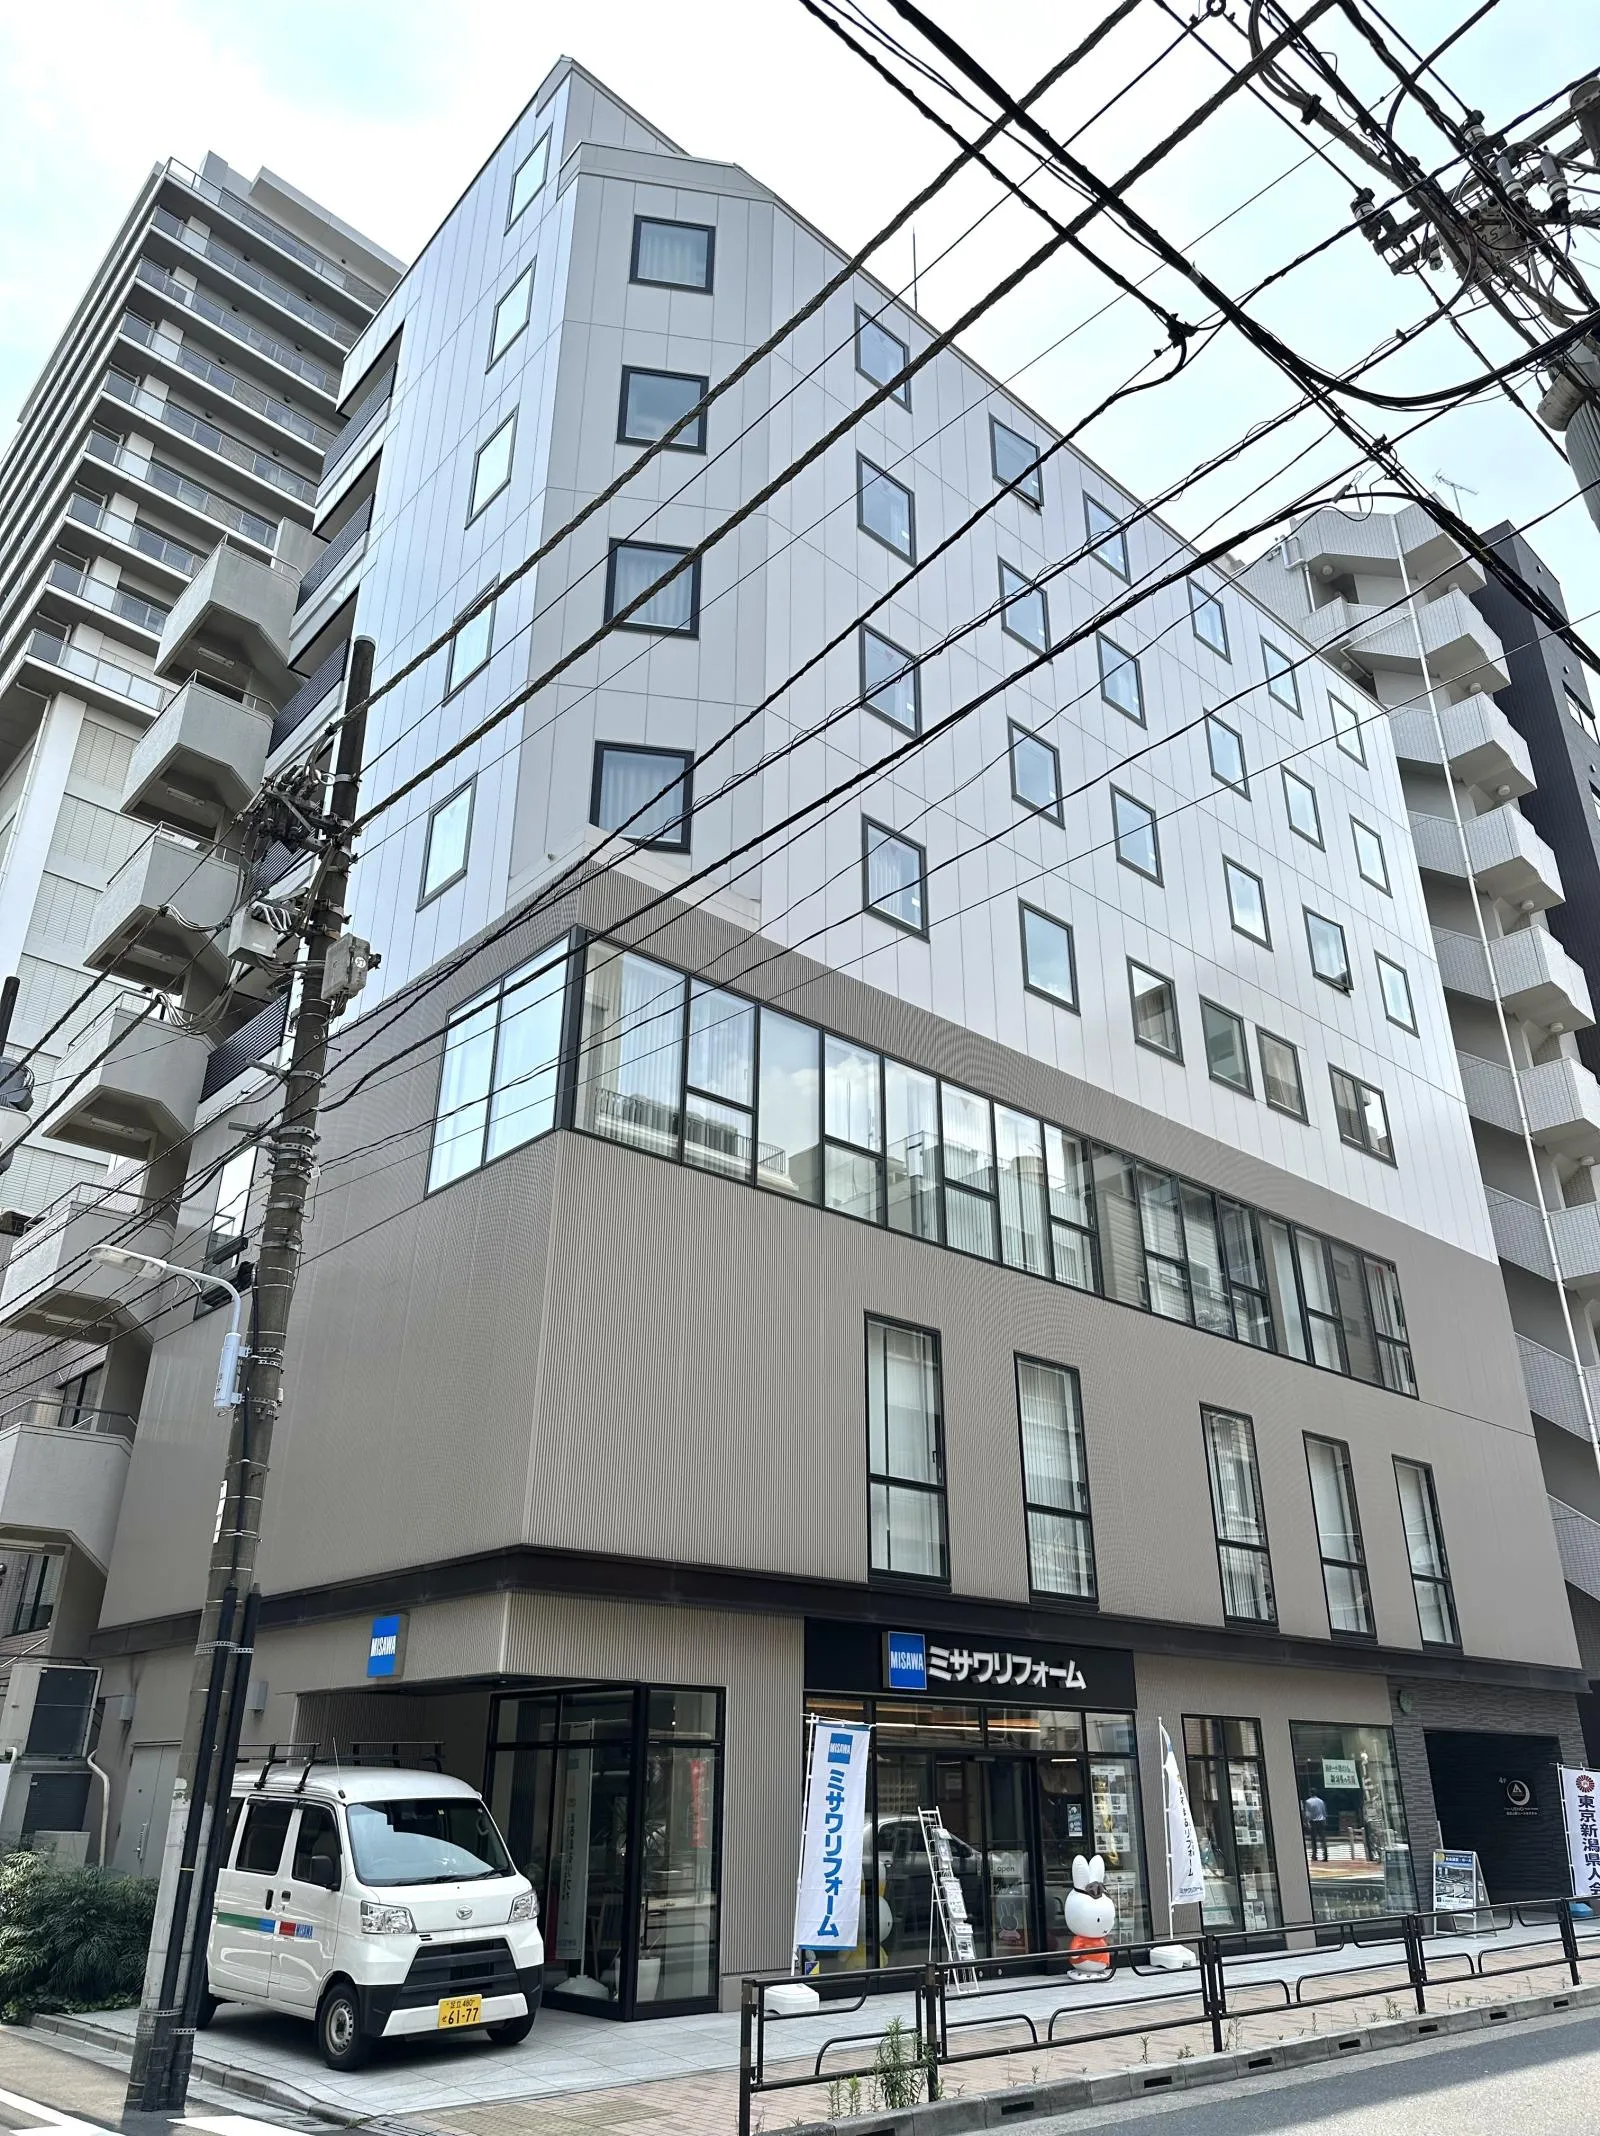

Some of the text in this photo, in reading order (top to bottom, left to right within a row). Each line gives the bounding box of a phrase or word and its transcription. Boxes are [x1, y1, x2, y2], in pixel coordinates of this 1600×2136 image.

[370, 1635, 396, 1657] MISAWA
[890, 1646, 1087, 1690] MISAWA ミサワリフォーム
[817, 1768, 845, 1938] ミサワリフォーム
[448, 2007, 479, 2025] 61-77
